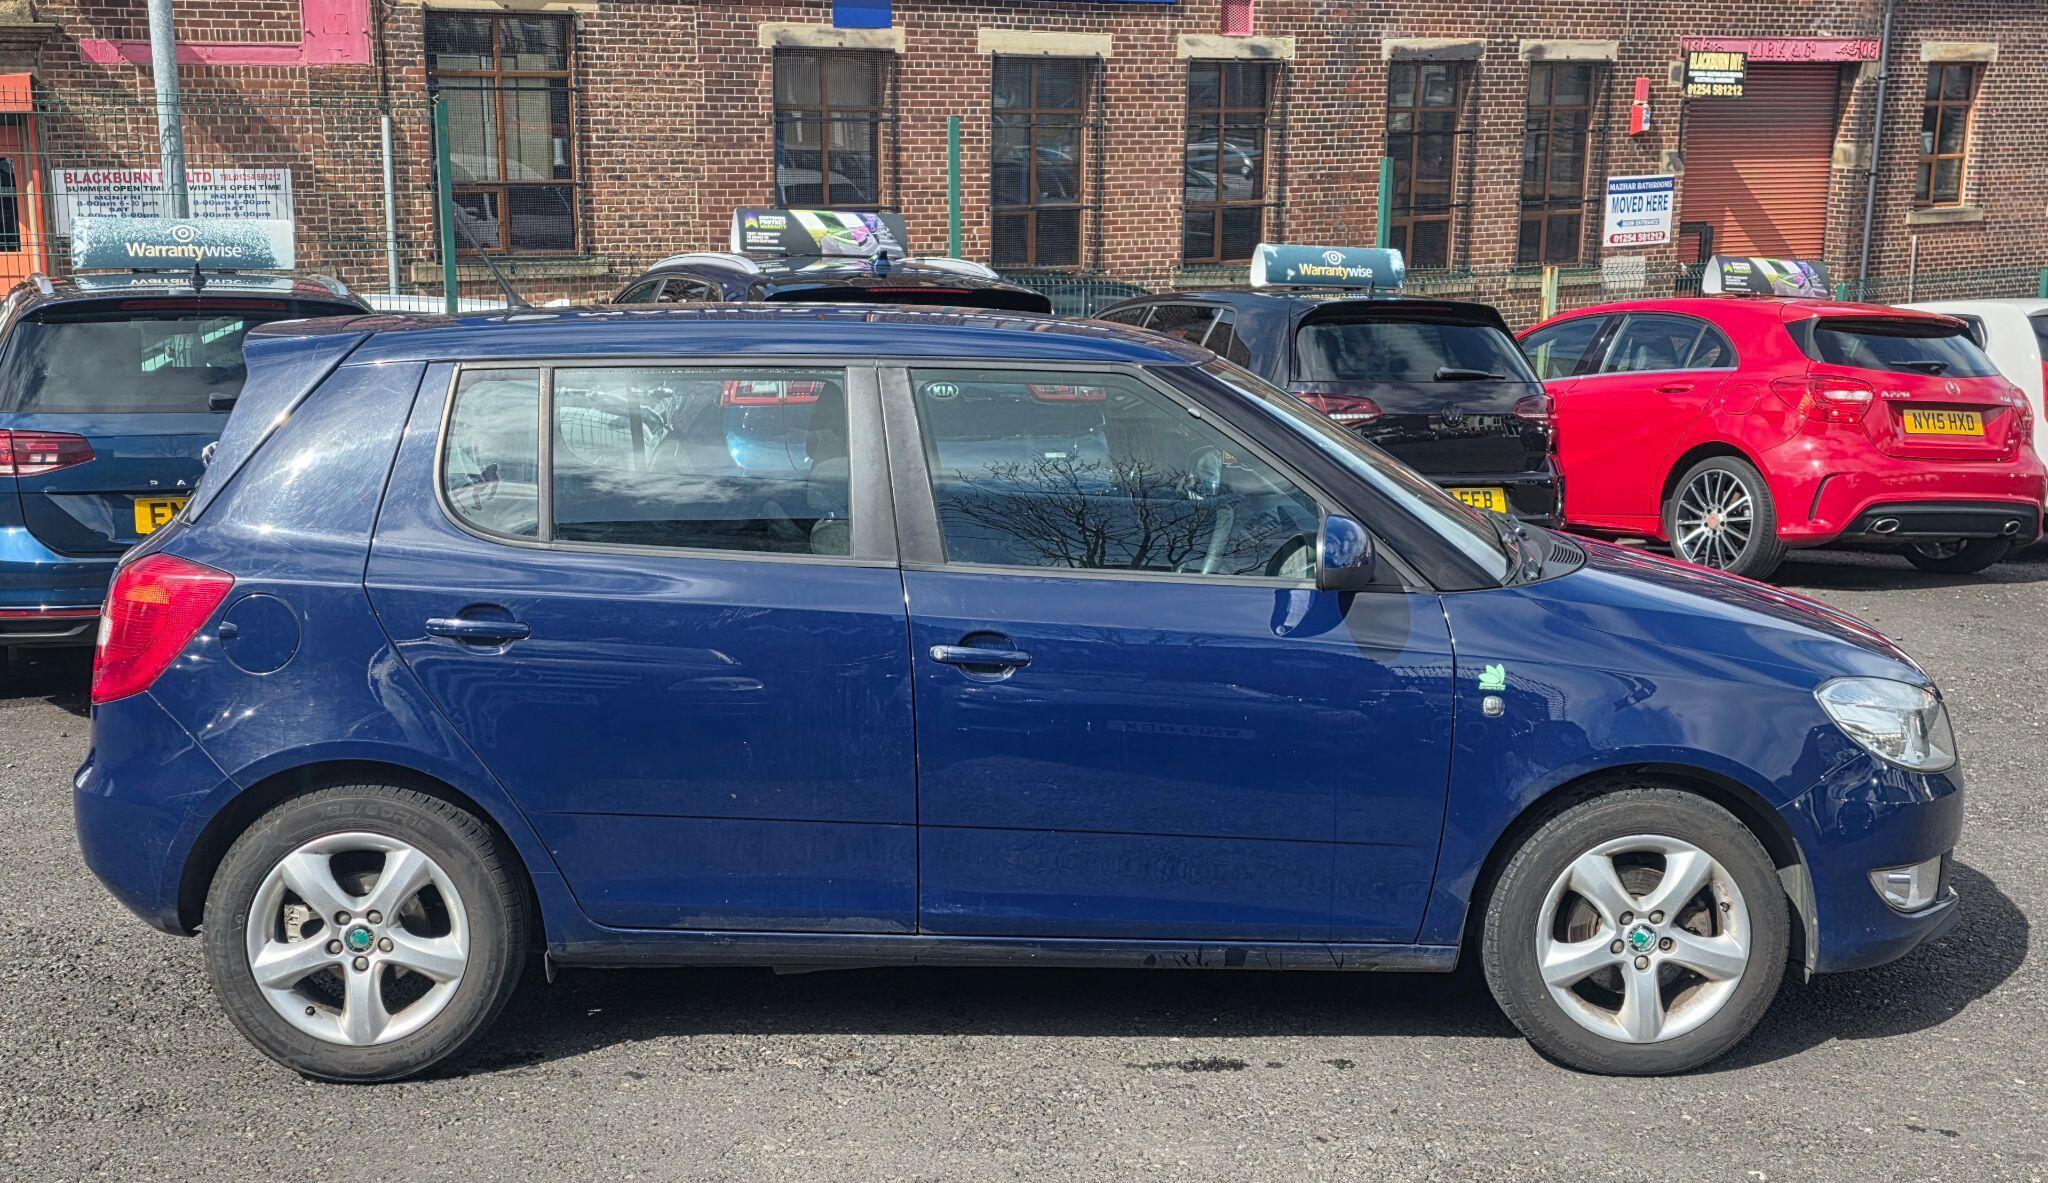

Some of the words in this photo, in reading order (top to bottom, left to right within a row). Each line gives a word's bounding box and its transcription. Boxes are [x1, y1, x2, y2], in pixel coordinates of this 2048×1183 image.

[1688, 83, 1711, 95] 01254
[1713, 84, 1743, 96] 581212
[64, 172, 152, 184] BLACKBURN
[186, 172, 212, 183] LTD
[1610, 183, 1637, 191] MAZHAR
[1637, 180, 1673, 190] BATHROOMS
[1612, 195, 1644, 213] MOVED
[1646, 194, 1669, 212] HERE
[1613, 233, 1637, 243] 01254
[125, 242, 242, 261] Warrantywise
[1299, 263, 1373, 280] Warrantywise
[933, 385, 954, 396] KIA
[1912, 412, 1945, 430] NY15
[1949, 412, 1975, 431] HXD
